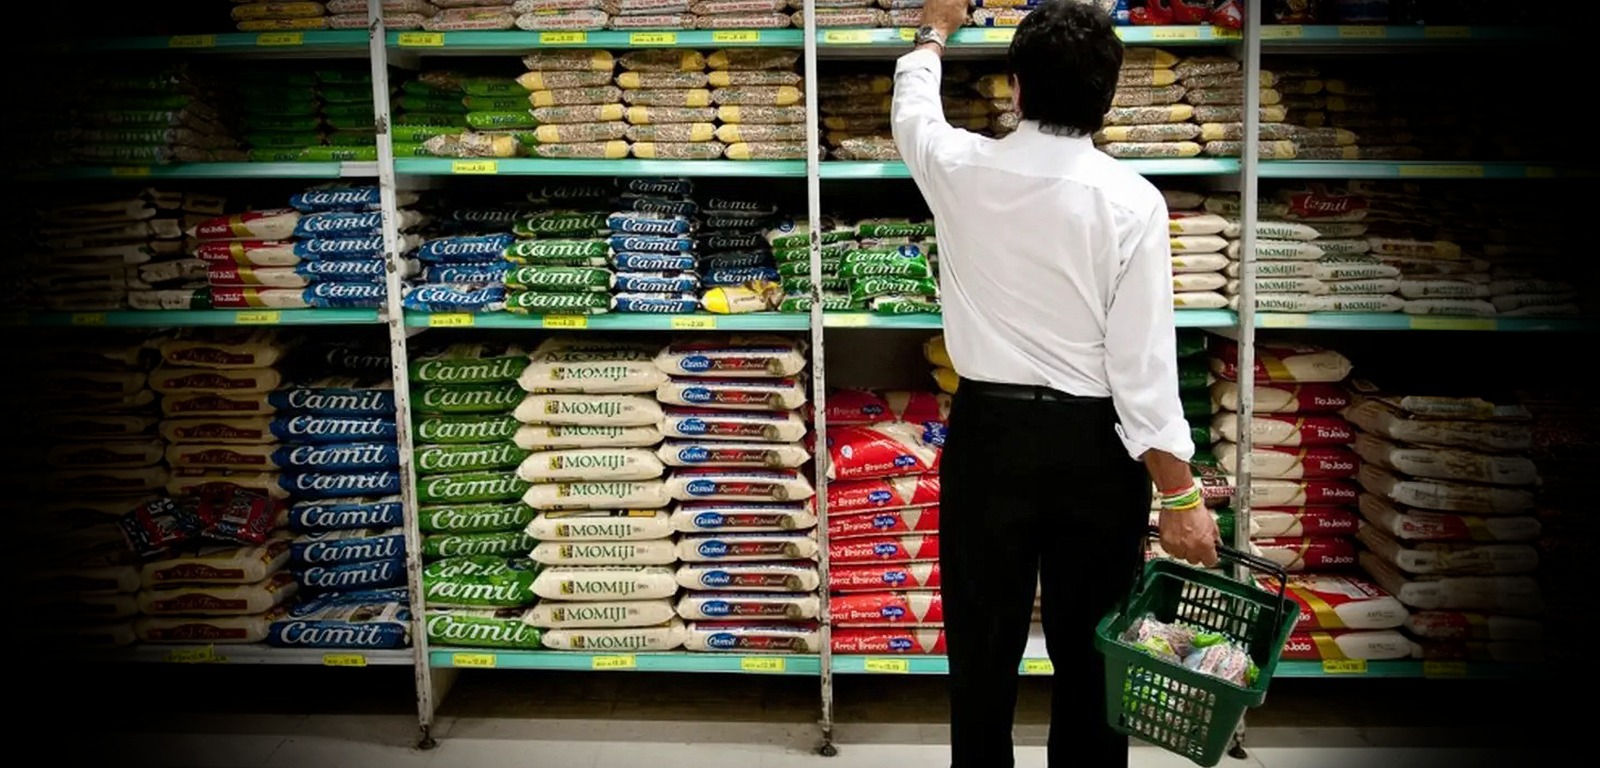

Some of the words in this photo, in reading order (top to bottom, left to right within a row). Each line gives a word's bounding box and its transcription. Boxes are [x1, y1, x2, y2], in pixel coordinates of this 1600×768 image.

[301, 188, 371, 204] Camil
[304, 211, 380, 232] Camil
[527, 215, 598, 231] Camil
[622, 217, 677, 233] Camil
[307, 238, 383, 252] Camil
[431, 239, 502, 255] Camil
[517, 241, 595, 256] Camil
[624, 238, 679, 251] Camil
[307, 261, 382, 274] Camil
[627, 255, 682, 269] Camil
[853, 261, 911, 275] Camil
[517, 268, 593, 285] Camil
[626, 275, 682, 291] Camil
[418, 287, 490, 303] Camil
[518, 292, 594, 307] Camil
[629, 299, 683, 313] Camil
[419, 359, 515, 380] Camil
[567, 367, 627, 380] MOMIJI
[289, 389, 384, 410] Camil
[424, 387, 516, 406] Camil
[561, 402, 621, 417] MOMIJI
[288, 416, 384, 434] Camil
[420, 417, 514, 438] Camil
[289, 444, 387, 465] Camil
[420, 446, 513, 468] Camil
[565, 455, 625, 470] MOMIJI
[297, 472, 392, 490] Camil
[428, 474, 521, 497] Camil
[573, 483, 632, 496] MOMIJI
[301, 505, 393, 526] Camil
[432, 508, 525, 529] Camil
[571, 524, 631, 537] MOMIJI
[304, 538, 397, 563] Camil
[440, 533, 532, 556] Camil
[575, 546, 635, 558] MOMIJI
[304, 563, 392, 587] Camil
[576, 581, 636, 594] MOMIJI
[567, 608, 627, 621] MOMIJI
[281, 622, 382, 645] Camil
[427, 616, 529, 641] Camil
[588, 636, 647, 650] MOMIJI
